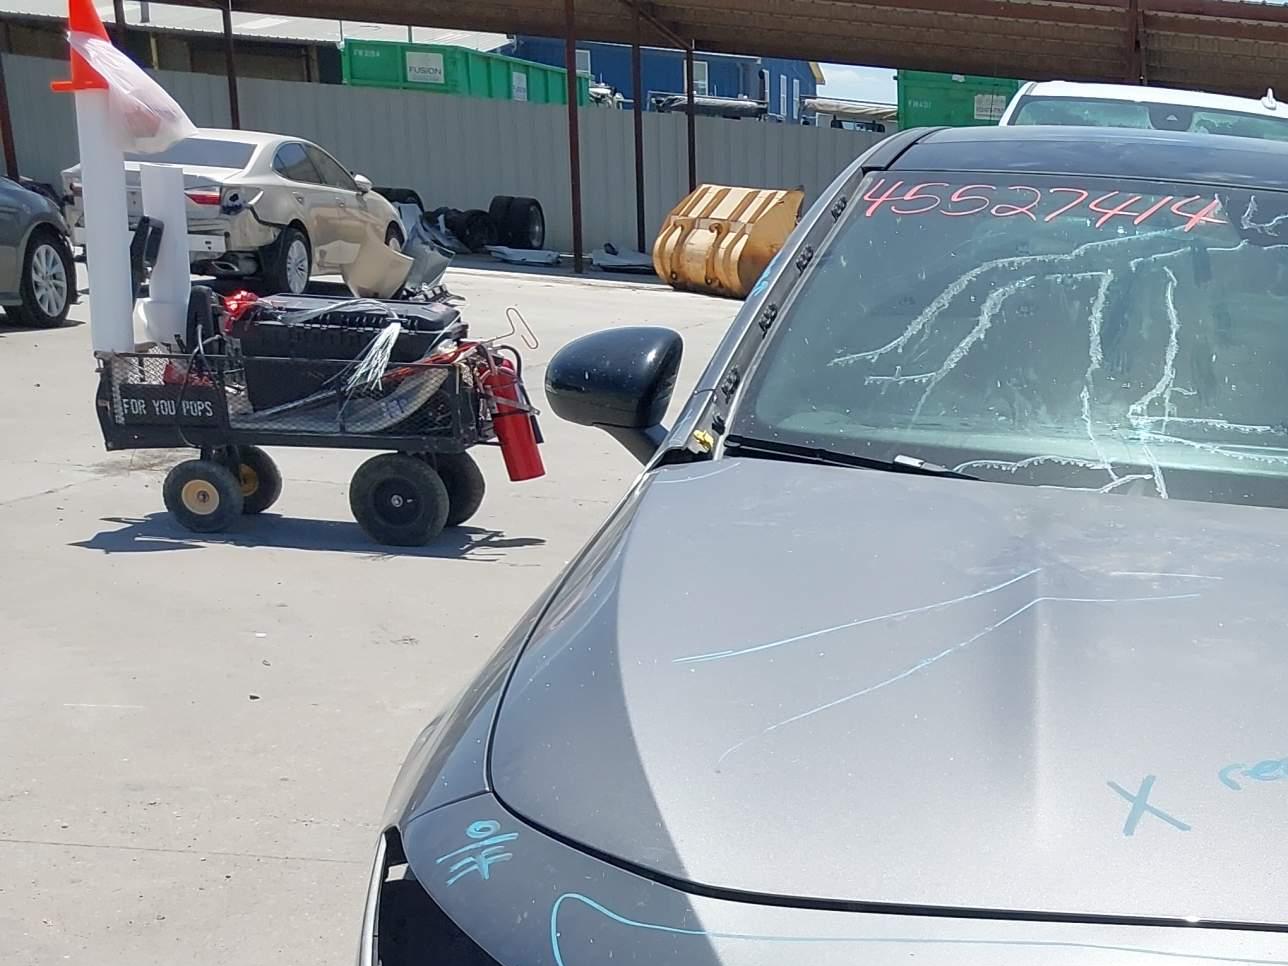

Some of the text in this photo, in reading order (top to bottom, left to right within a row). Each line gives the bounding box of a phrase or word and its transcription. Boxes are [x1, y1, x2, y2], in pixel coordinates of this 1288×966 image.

[408, 65, 442, 76] FUSION
[863, 179, 1228, 233] 45527414
[122, 399, 214, 417] FOR YOU POPS
